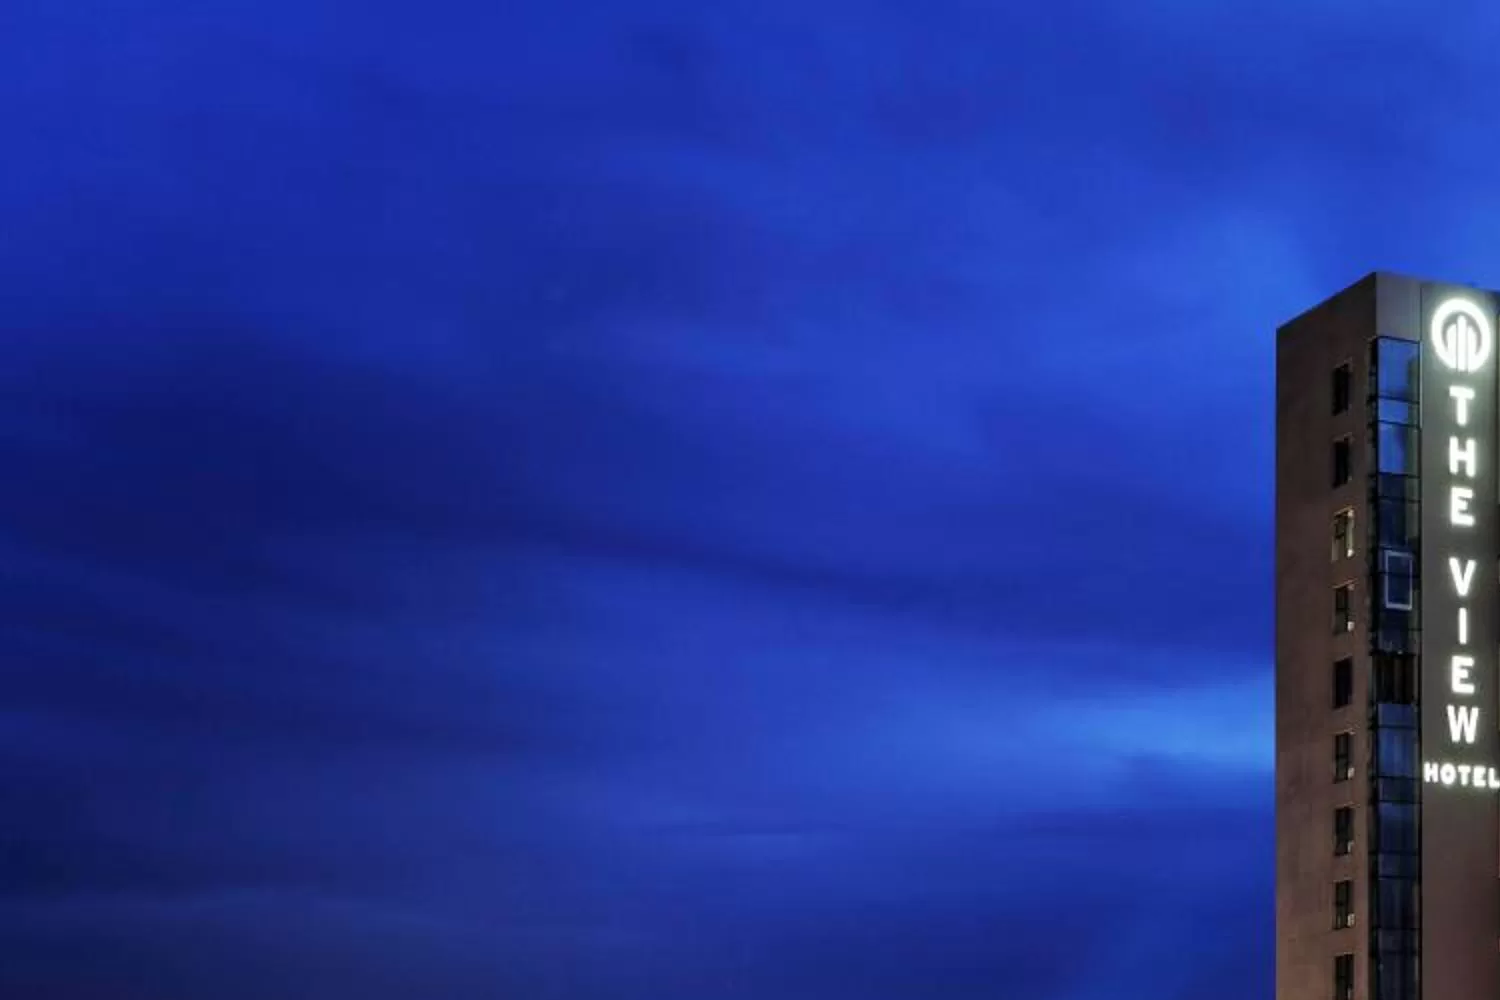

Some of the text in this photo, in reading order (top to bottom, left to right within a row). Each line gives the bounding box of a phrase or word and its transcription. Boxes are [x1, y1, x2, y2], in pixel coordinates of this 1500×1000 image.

[1447, 385, 1479, 745] THE VIEW
[1424, 762, 1500, 788] HOTEL
